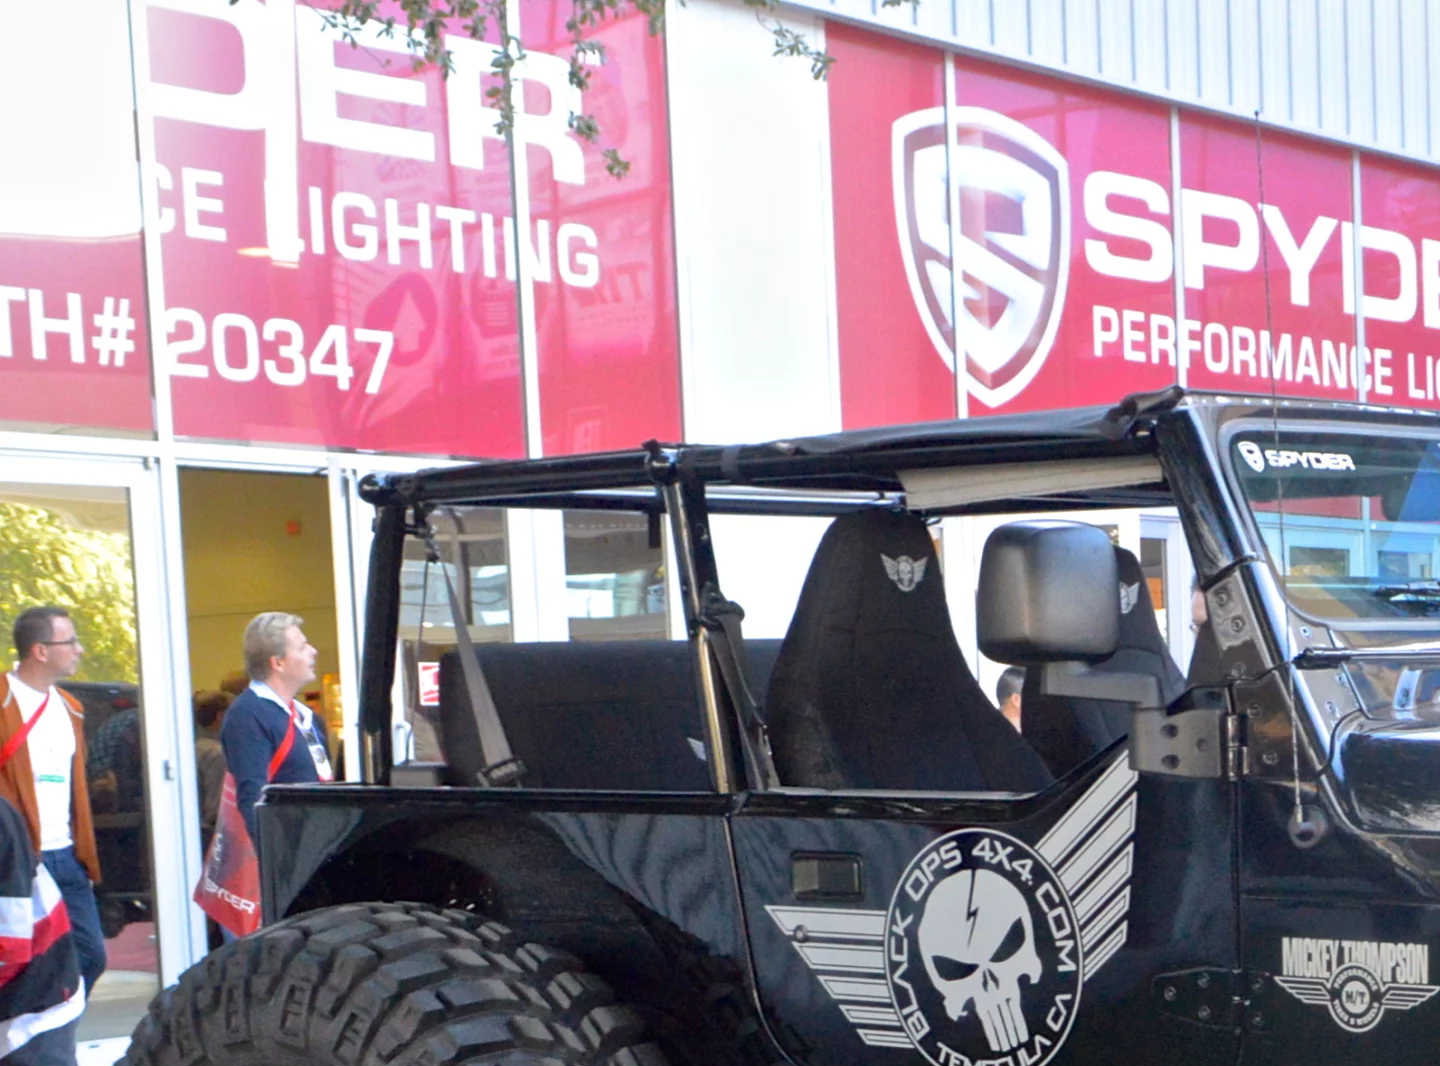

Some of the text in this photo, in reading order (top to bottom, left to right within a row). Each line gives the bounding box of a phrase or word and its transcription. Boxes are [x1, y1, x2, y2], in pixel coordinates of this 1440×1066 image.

[165, 305, 396, 395] 20347
[1092, 304, 1394, 396] PERFORMANCE
[1264, 448, 1356, 472] SPYDER
[904, 840, 963, 902] OPS
[890, 907, 931, 1041] BLACK
[1281, 936, 1429, 985] MICKEY THOMPSON
